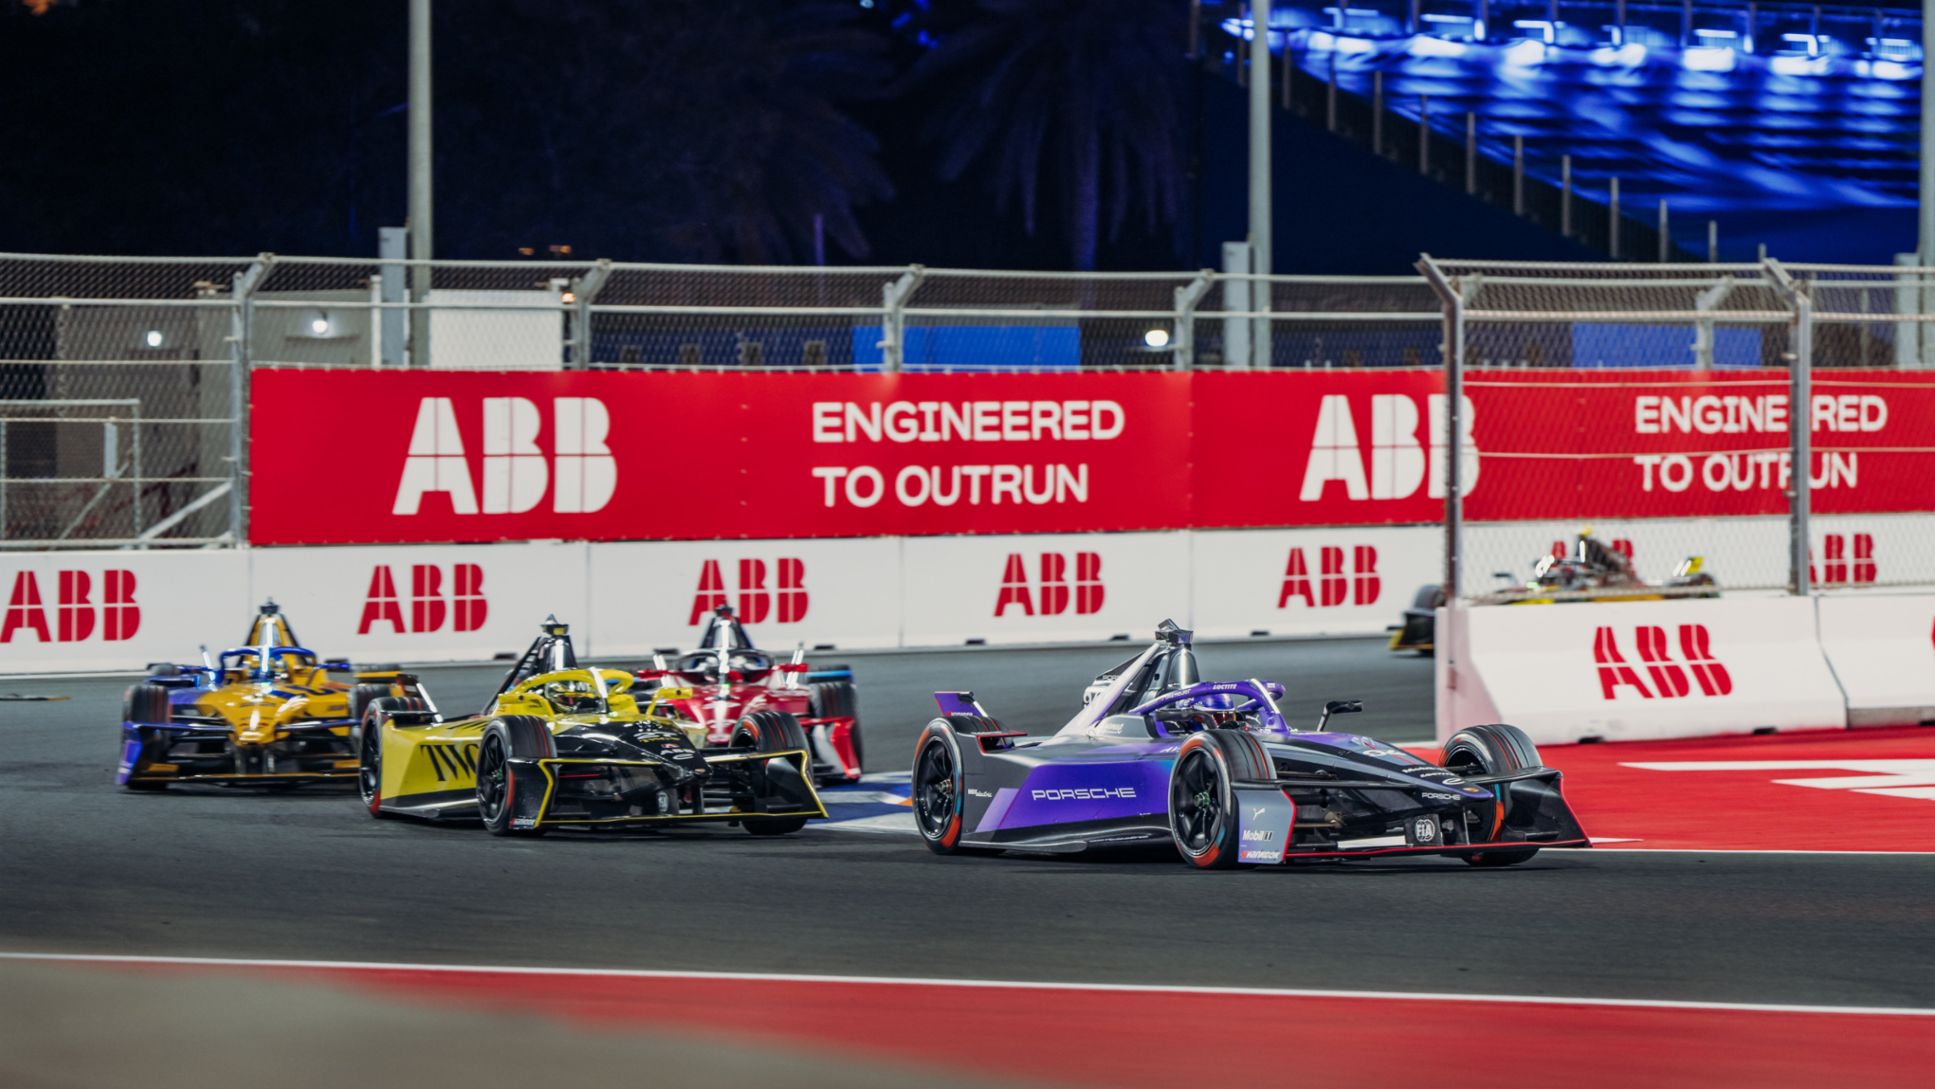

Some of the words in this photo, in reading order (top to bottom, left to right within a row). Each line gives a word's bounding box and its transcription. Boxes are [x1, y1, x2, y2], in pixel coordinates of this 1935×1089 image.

[814, 401, 1124, 442] ENGINEERED
[1634, 395, 1887, 433] ENGINERED
[394, 398, 616, 514] ABB
[1299, 393, 1481, 501] ABB
[1633, 455, 1692, 491] TO
[813, 467, 883, 507] TO
[897, 465, 1087, 506] OUTRUN
[995, 552, 1104, 617] ABB
[1278, 545, 1381, 608] ABB
[1809, 533, 1877, 584] BB
[0, 570, 140, 643] ABB
[359, 563, 489, 635] ABB
[688, 558, 810, 627] ABB
[1593, 624, 1732, 700] ABB
[1032, 787, 1137, 801] PORSCHE
[1422, 792, 1461, 800] PORSCHE
[1242, 830, 1264, 841] Mobil
